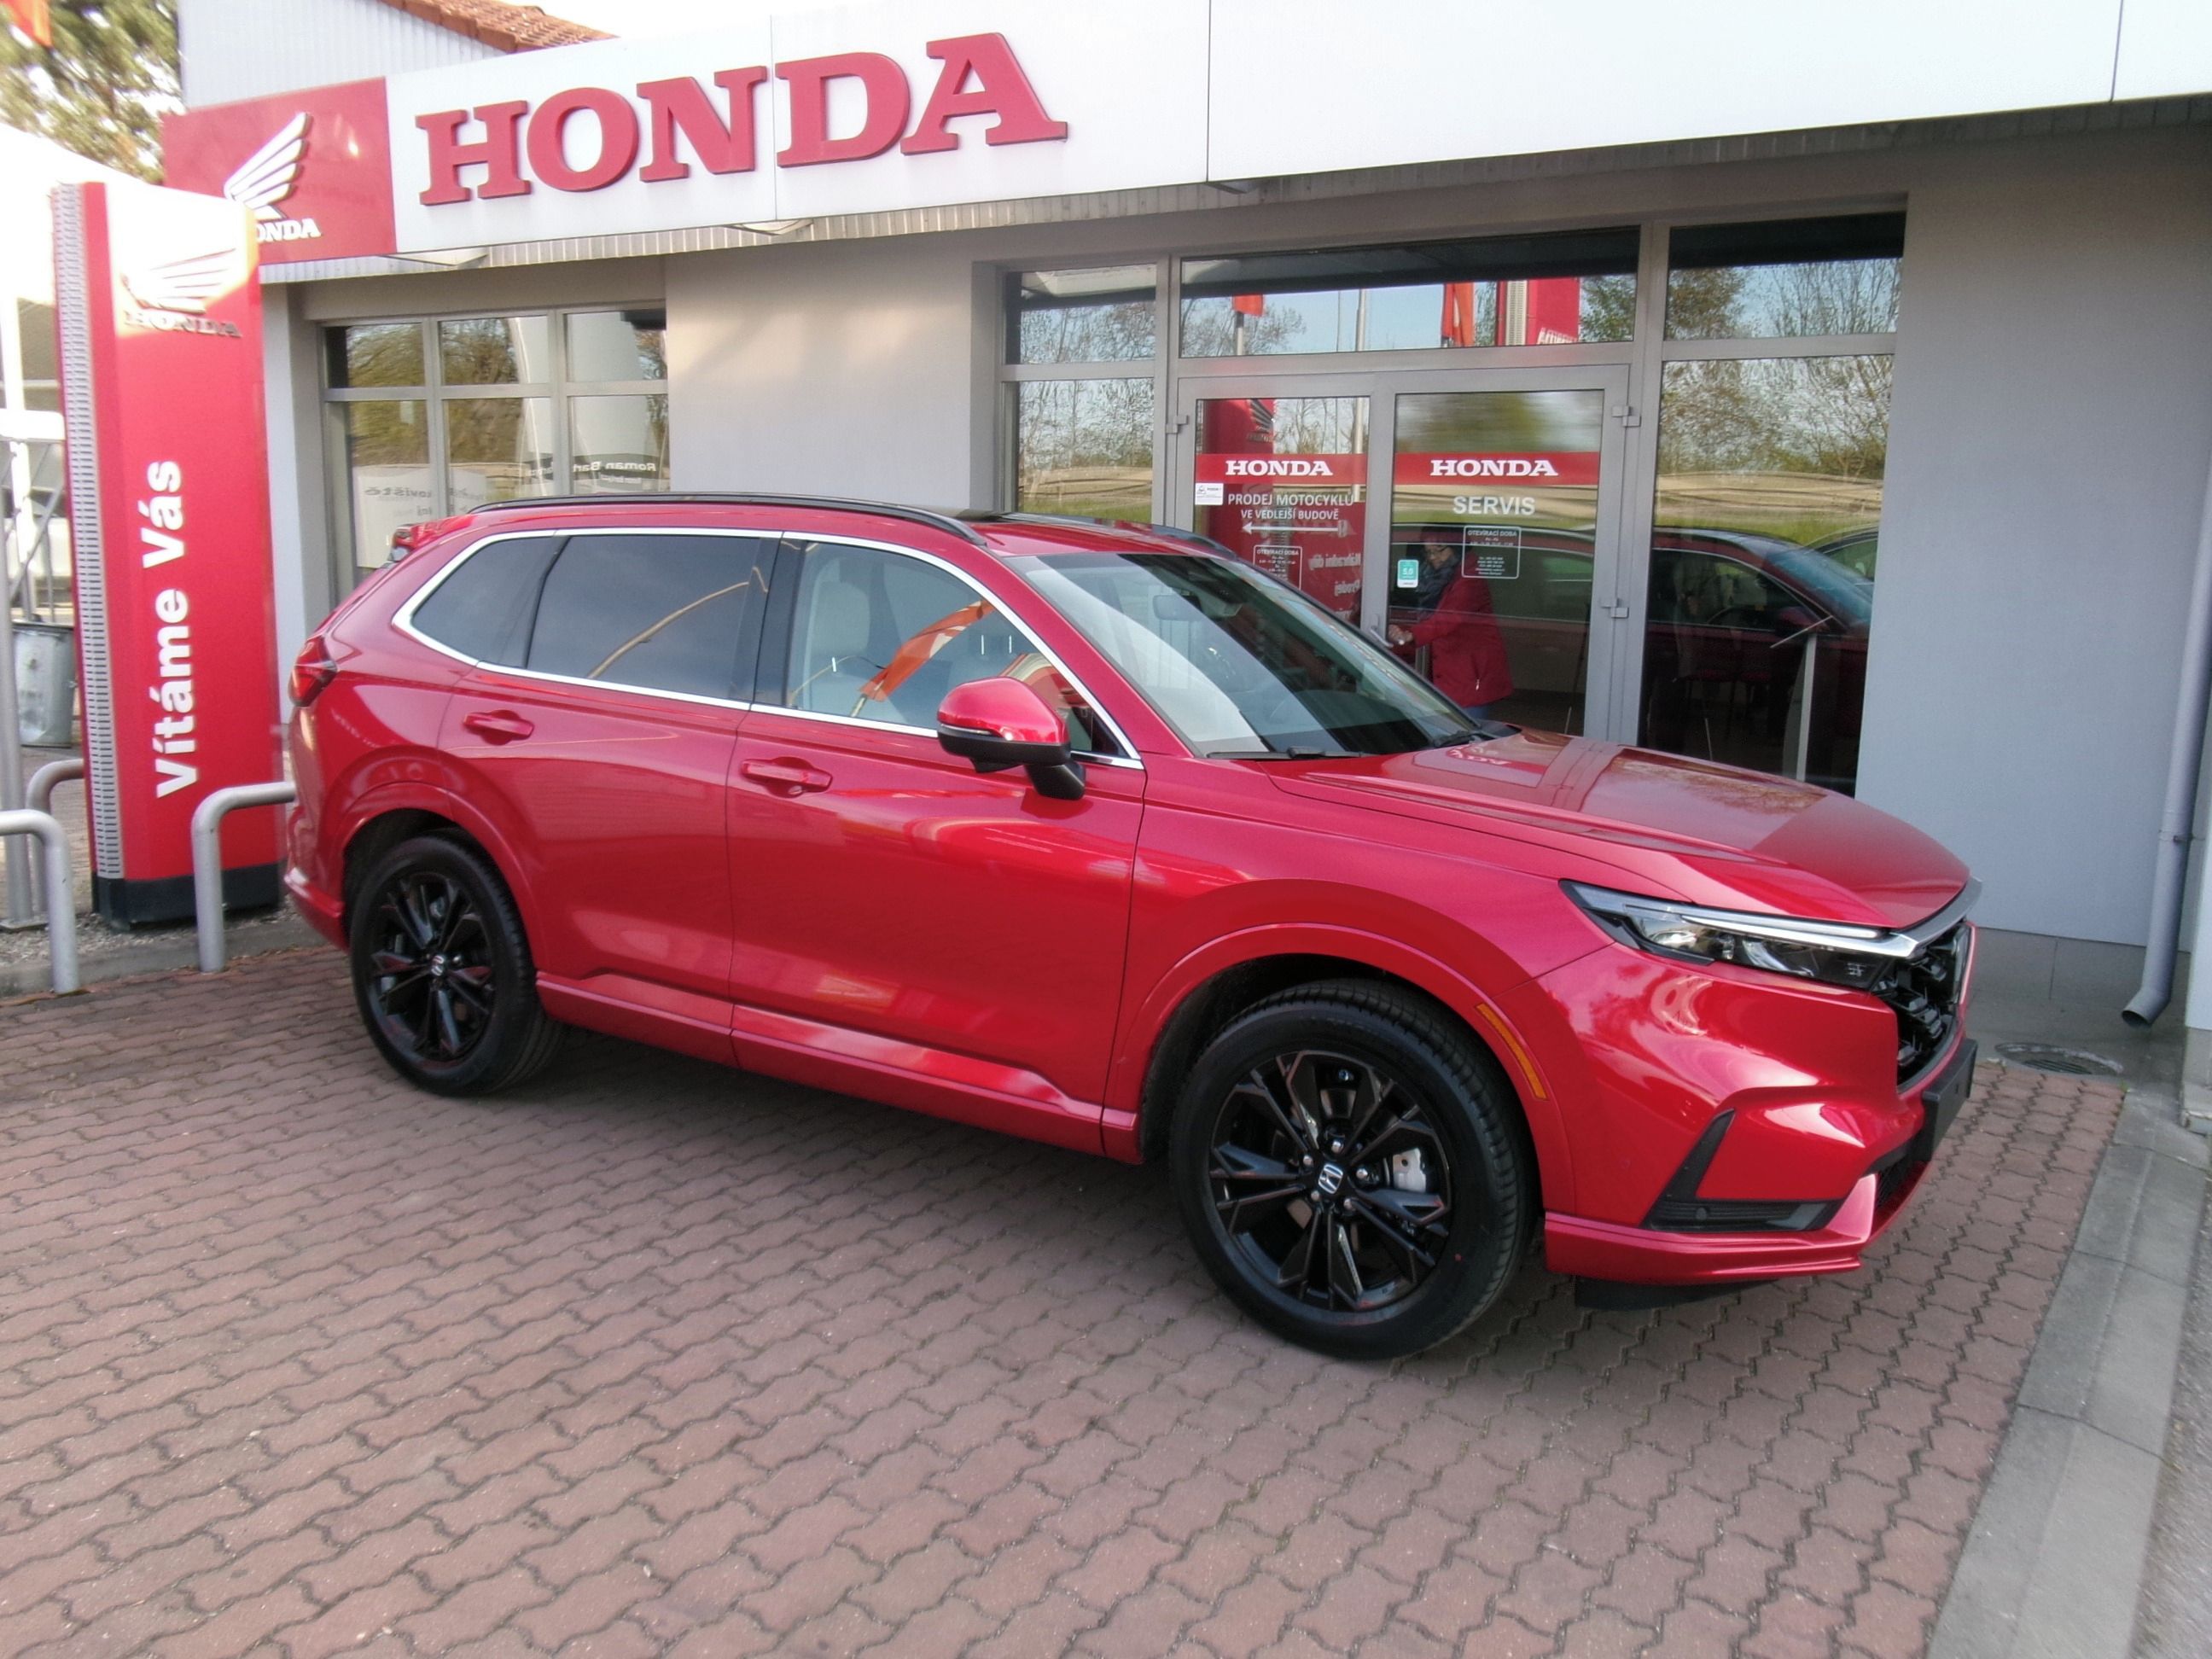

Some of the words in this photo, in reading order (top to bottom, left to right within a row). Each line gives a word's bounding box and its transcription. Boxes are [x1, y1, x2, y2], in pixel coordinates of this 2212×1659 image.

[416, 32, 1068, 206] HONDA
[256, 218, 321, 243] ONDA
[1225, 460, 1333, 476] HONDA
[1430, 459, 1558, 476] HONDA
[1228, 493, 1272, 505] PRODEJ
[1452, 496, 1536, 515] SERVIS
[137, 461, 185, 568] Vás
[1241, 509, 1253, 519] VE
[1256, 509, 1296, 520] VEDLEJŠÍ
[1298, 509, 1339, 520] BUDOVĚ
[149, 588, 198, 799] Vítáme
